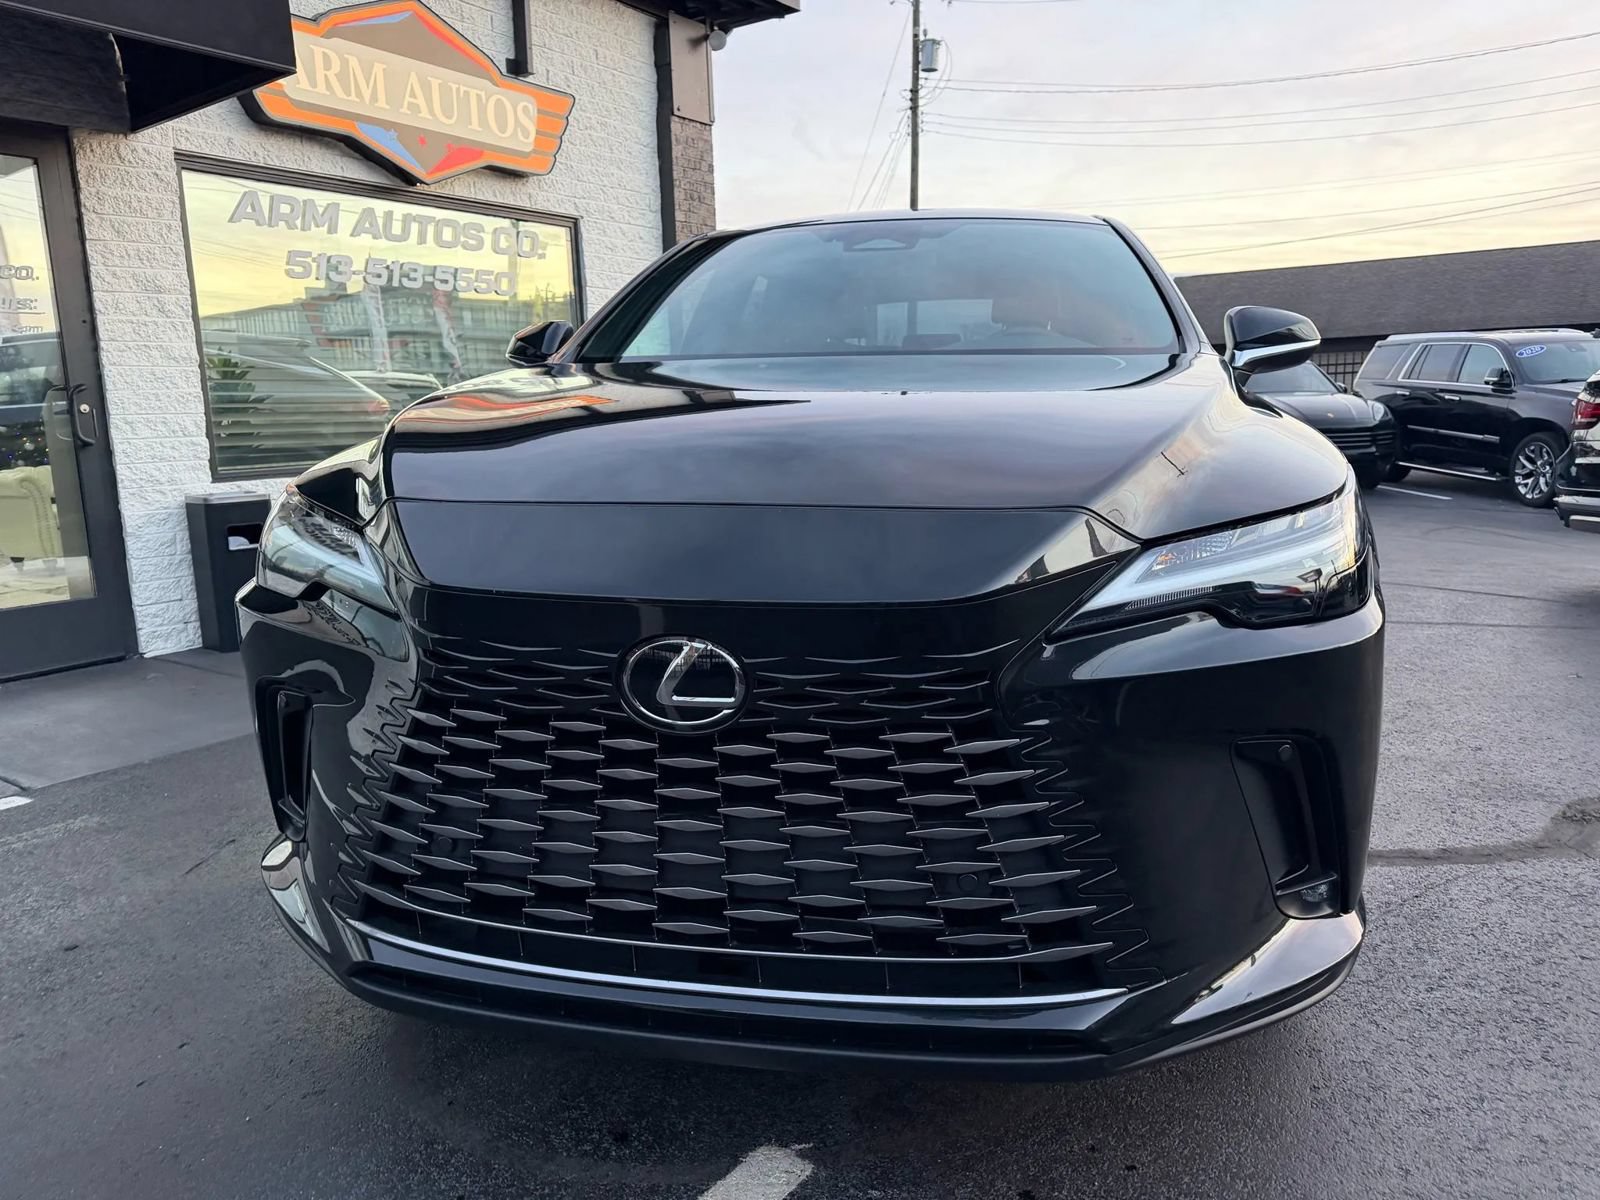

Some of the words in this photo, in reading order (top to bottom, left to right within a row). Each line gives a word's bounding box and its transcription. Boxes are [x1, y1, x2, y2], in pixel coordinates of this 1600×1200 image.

[400, 71, 535, 143] AUTOS
[228, 190, 340, 235] ARM
[350, 206, 485, 251] AUTOS
[284, 249, 517, 297] 513-513-5550
